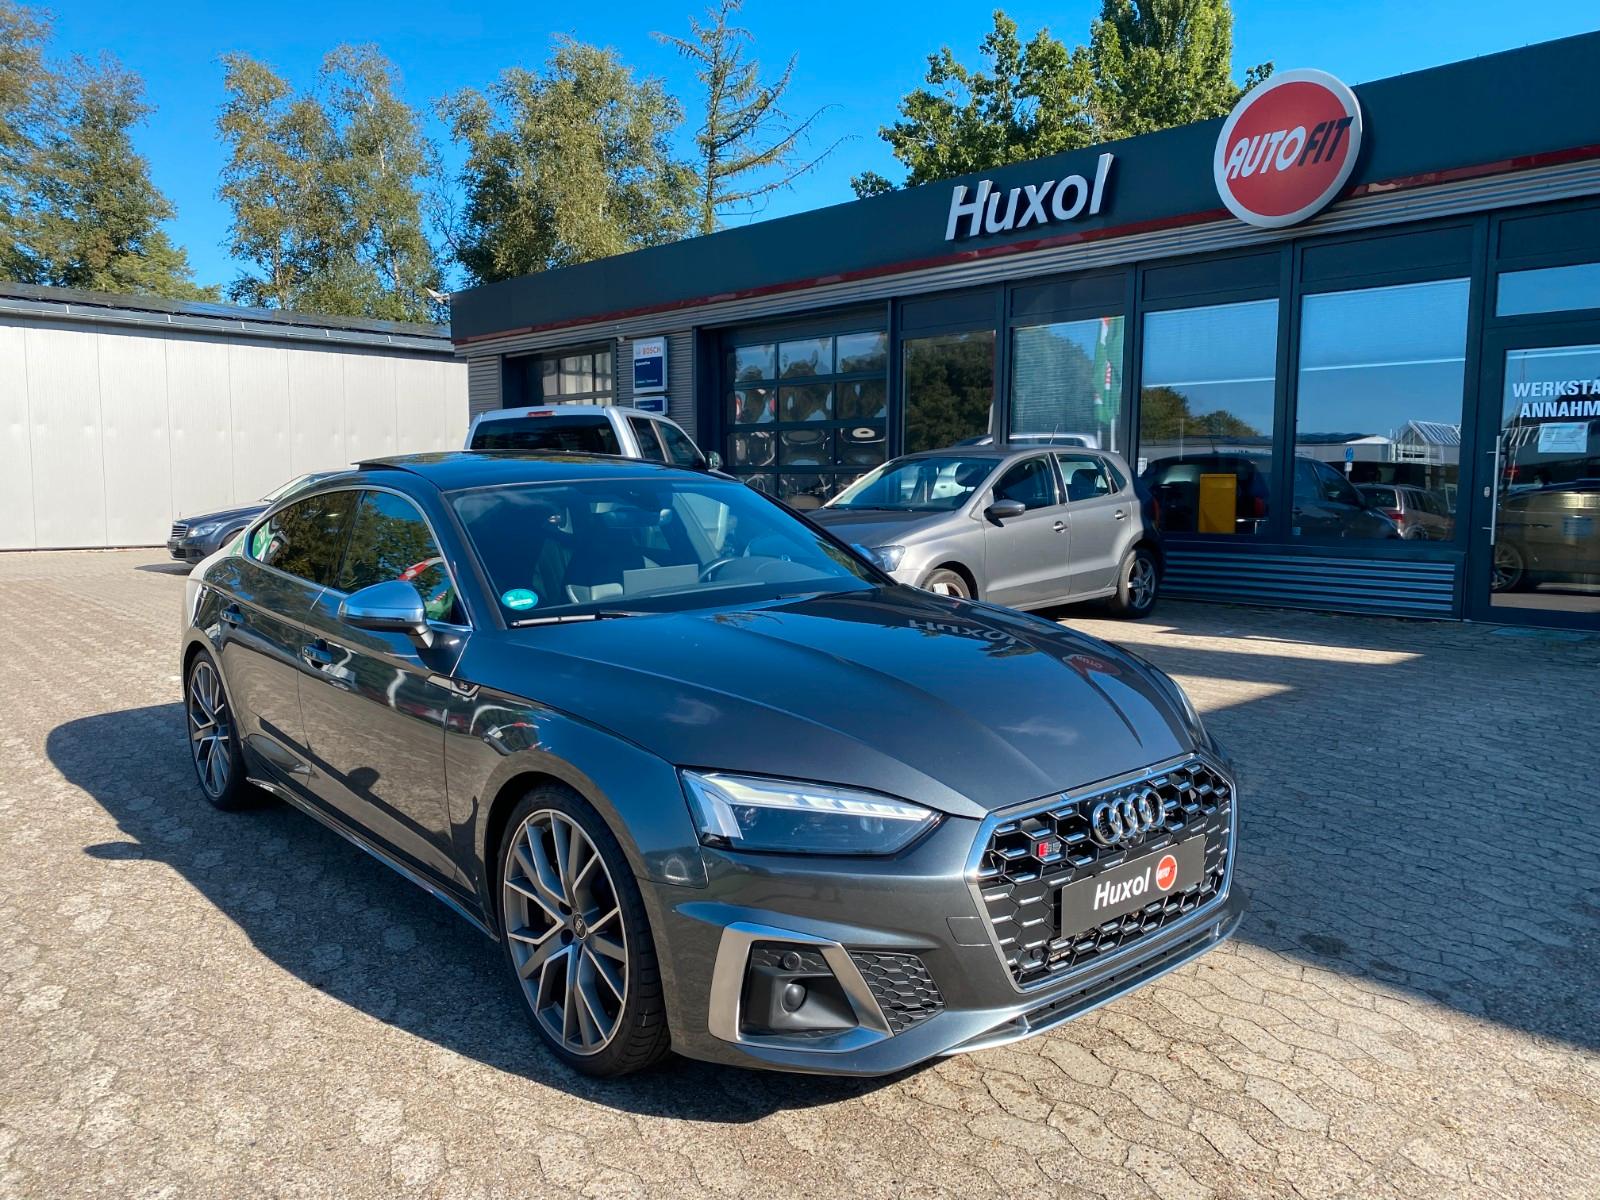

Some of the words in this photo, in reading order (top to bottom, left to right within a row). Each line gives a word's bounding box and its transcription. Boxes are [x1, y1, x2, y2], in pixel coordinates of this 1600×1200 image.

[1224, 116, 1355, 180] AUTOFIT
[945, 153, 1115, 241] Huxol
[1520, 400, 1600, 418] ANNAHM
[1093, 866, 1151, 911] Huxol
